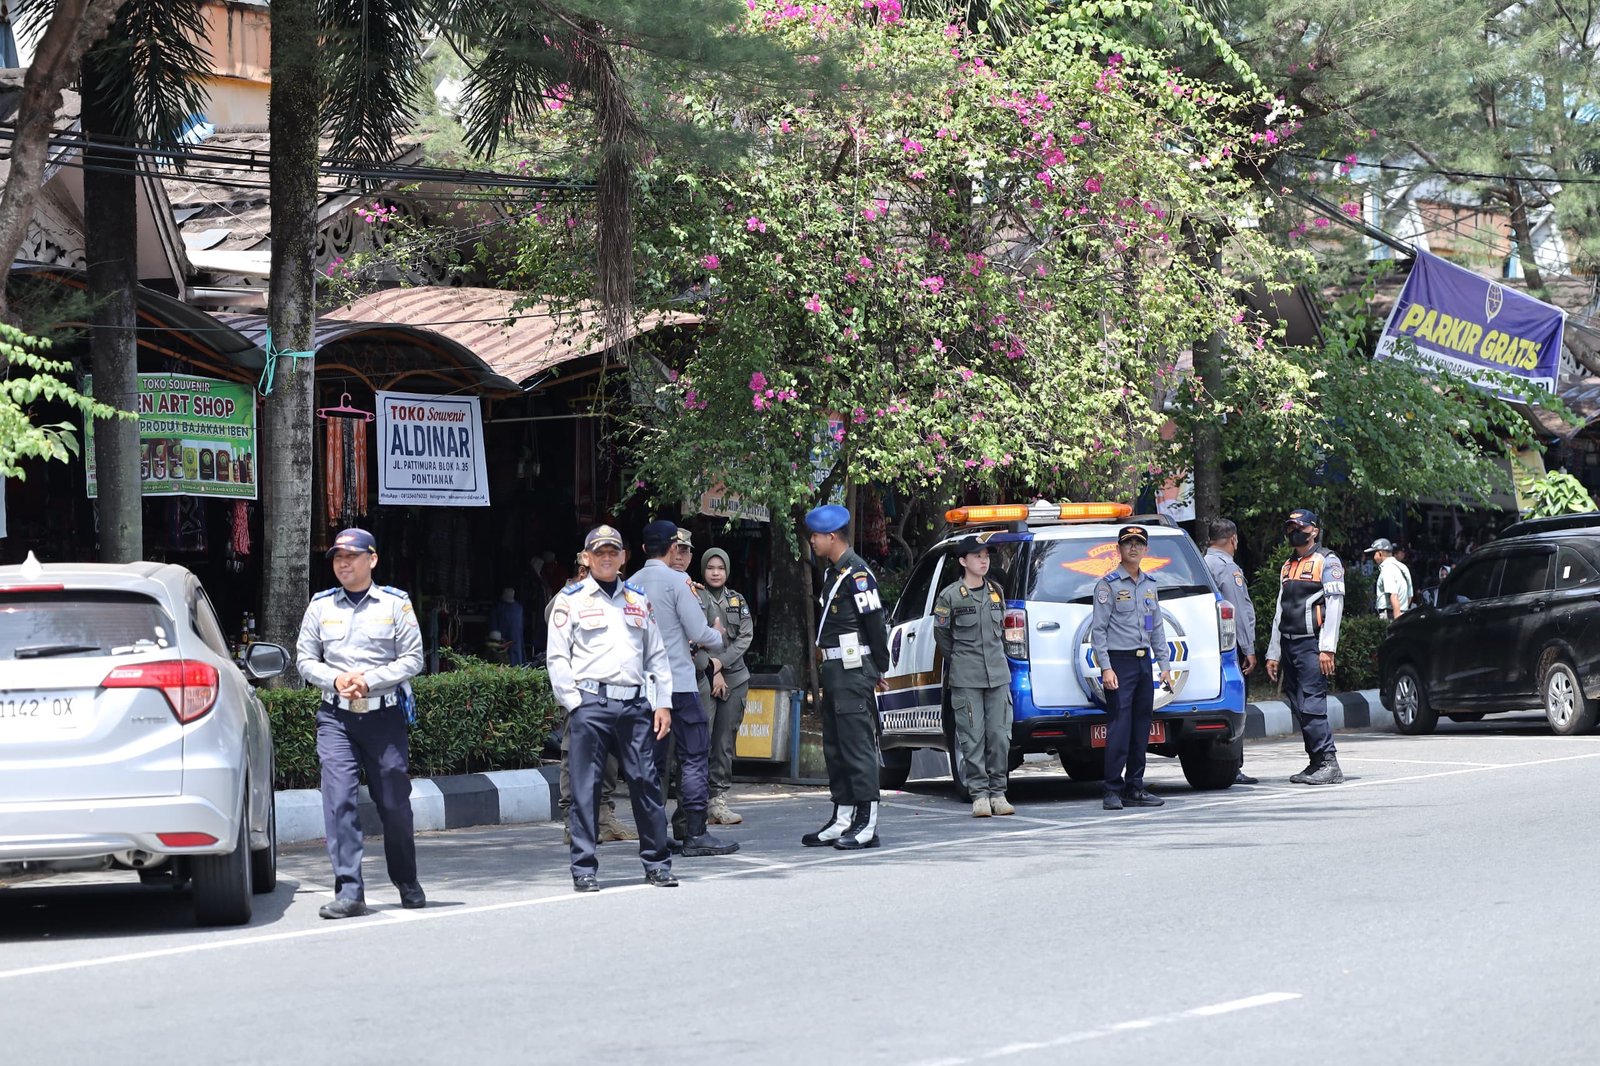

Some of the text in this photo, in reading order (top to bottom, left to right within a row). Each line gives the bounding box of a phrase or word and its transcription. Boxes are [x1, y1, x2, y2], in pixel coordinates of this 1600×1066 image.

[1399, 304, 1543, 370] PARKIR GRATIS
[143, 379, 211, 393] TOKO SOUVENIR
[158, 394, 190, 415] ART
[193, 395, 236, 419] SHOP
[390, 405, 466, 422] TOKO Souvenir
[182, 422, 225, 436] BAJAKAH
[227, 425, 249, 438] IBEN
[390, 423, 471, 458] ALDINAR
[392, 460, 403, 470] JL.
[403, 460, 437, 471] PATTIMURA
[438, 462, 454, 471] BLOK
[411, 473, 454, 485] PONTIANAK
[853, 588, 882, 614] PM
[1094, 726, 1107, 739] KB
